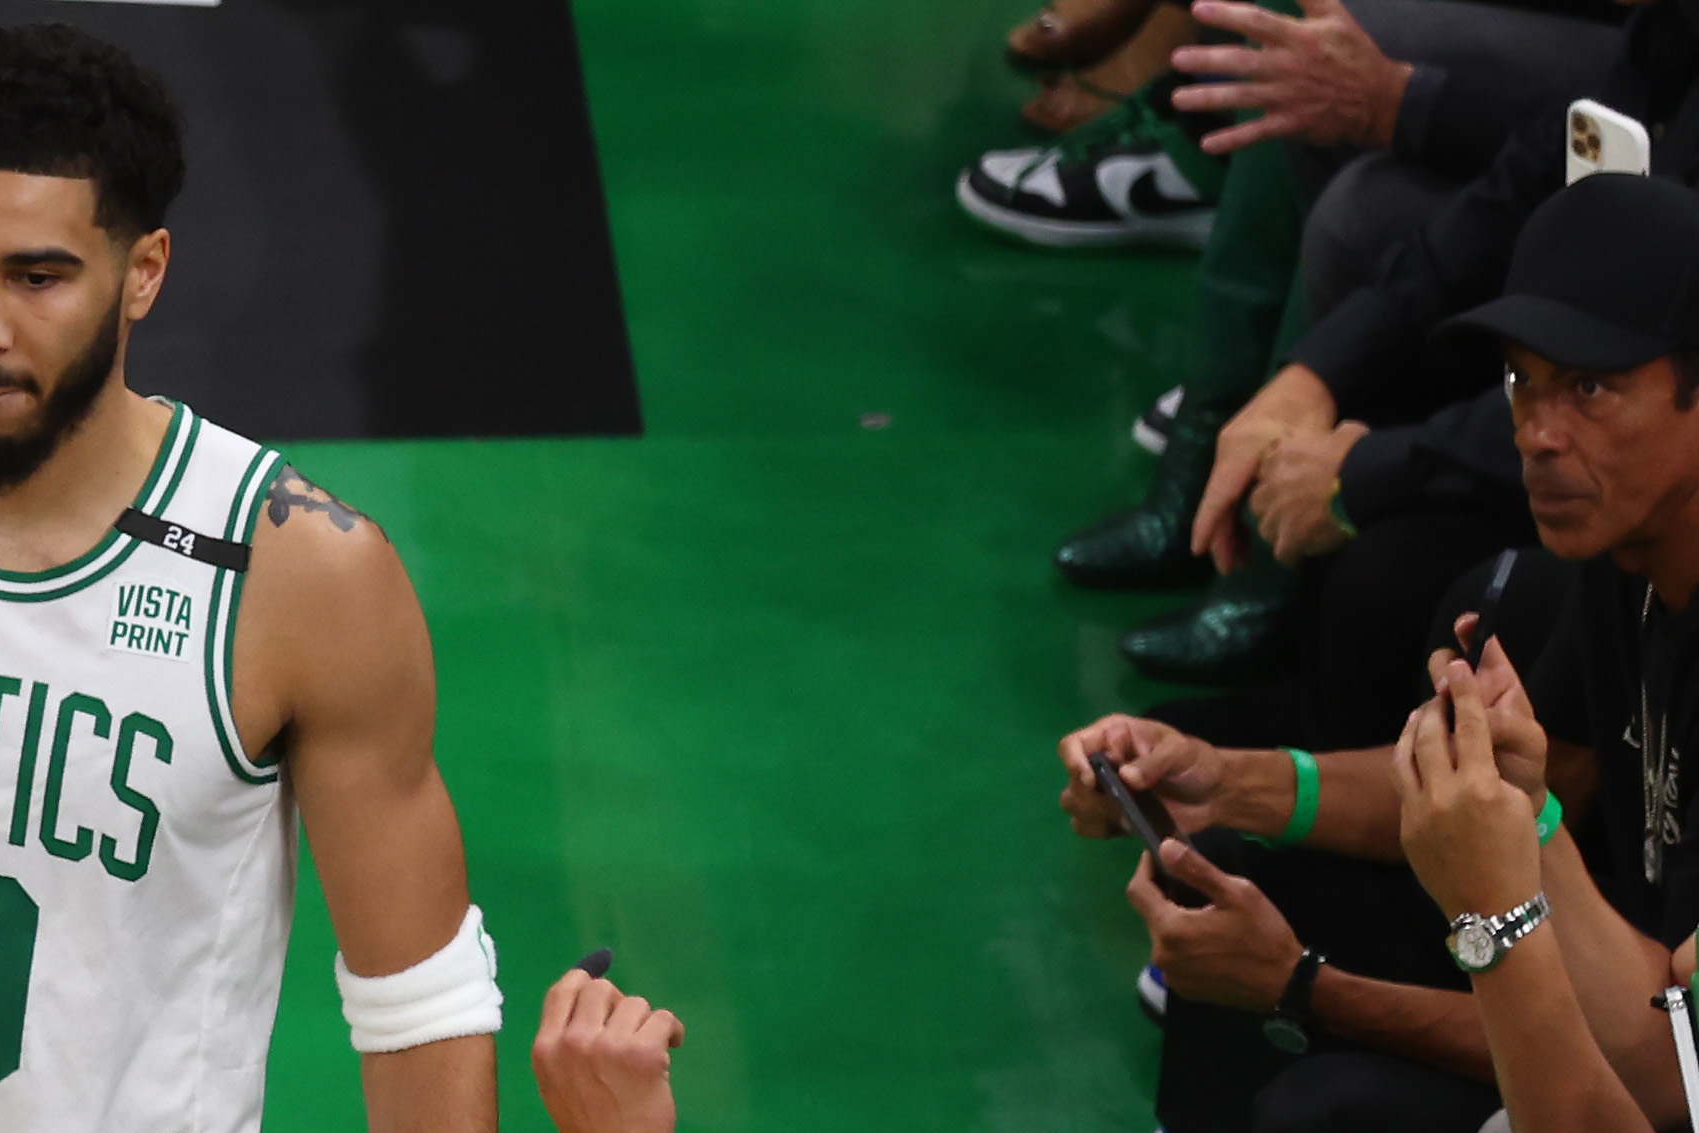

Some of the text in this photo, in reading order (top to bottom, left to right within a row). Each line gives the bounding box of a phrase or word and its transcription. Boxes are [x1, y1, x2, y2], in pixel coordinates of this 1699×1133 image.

[163, 526, 196, 556] 24
[117, 585, 193, 631] VISTA
[110, 620, 190, 657] PRINT
